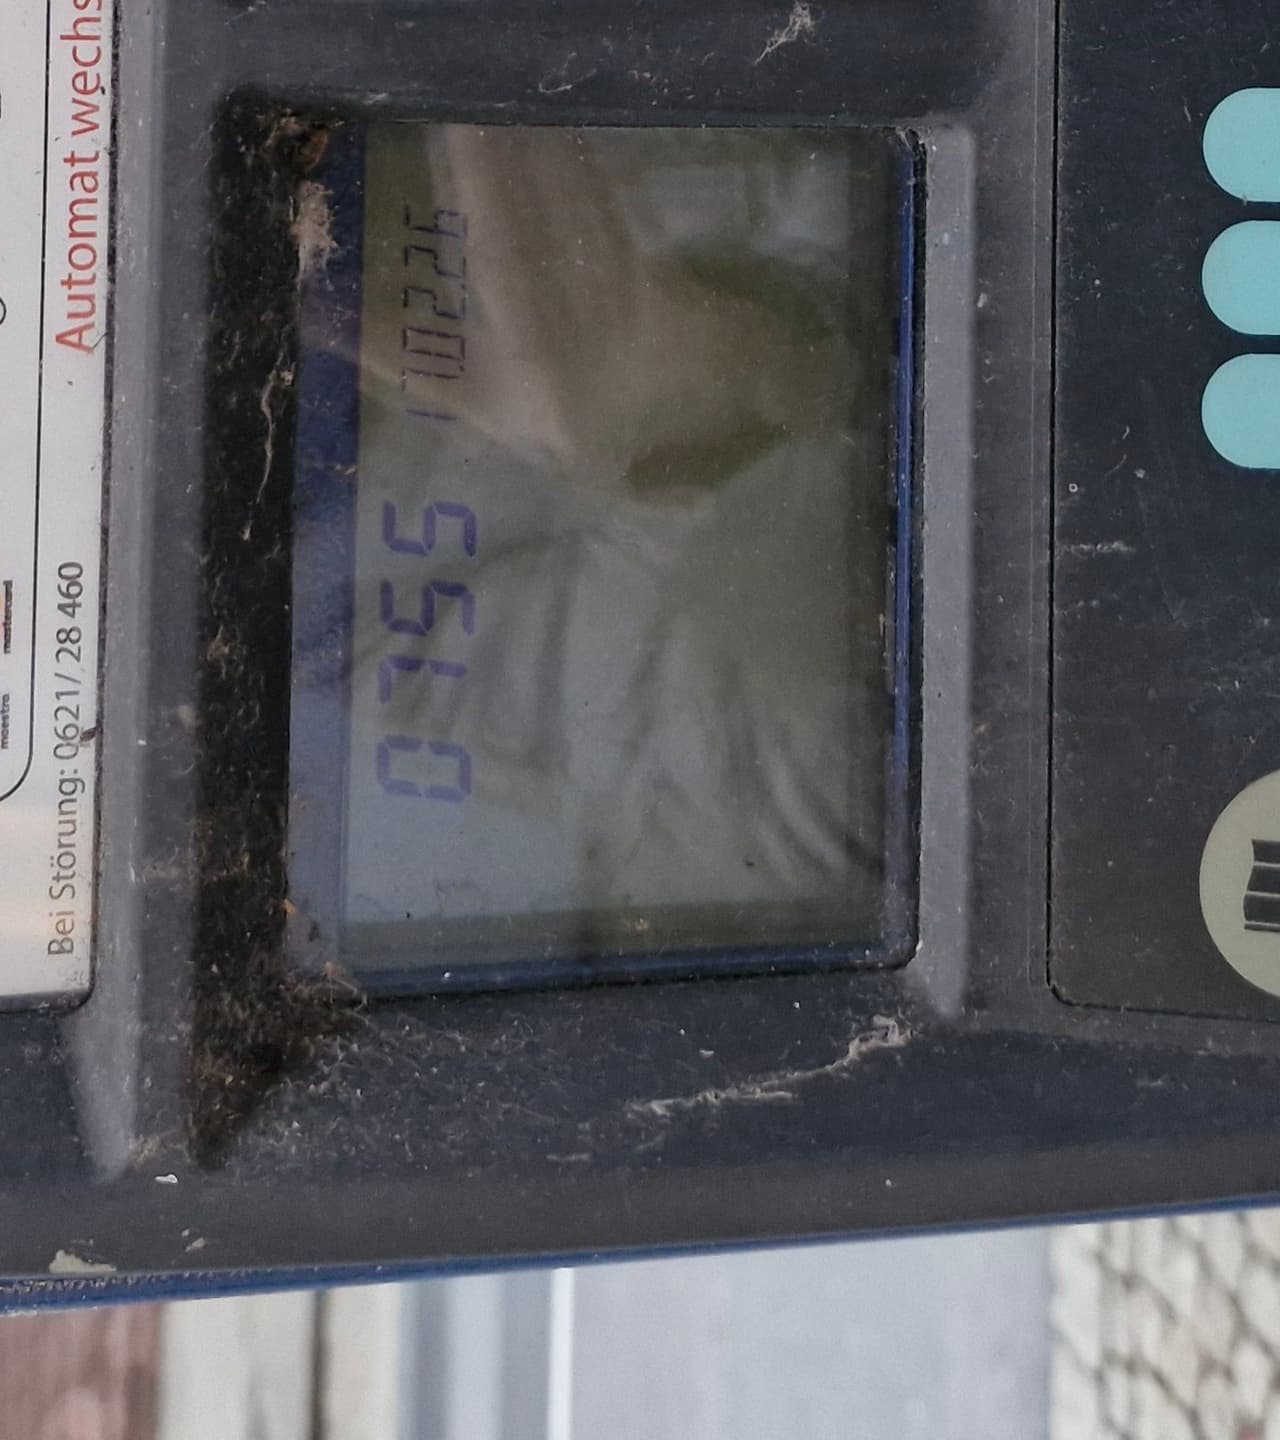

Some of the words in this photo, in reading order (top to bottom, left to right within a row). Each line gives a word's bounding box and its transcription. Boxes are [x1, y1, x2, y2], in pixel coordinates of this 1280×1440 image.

[56, 151, 99, 354] Automat
[56, 561, 82, 618] 460
[55, 626, 81, 664] 28
[52, 673, 82, 760] 0621/
[48, 769, 85, 899] Störung:
[47, 910, 74, 956] Bei
